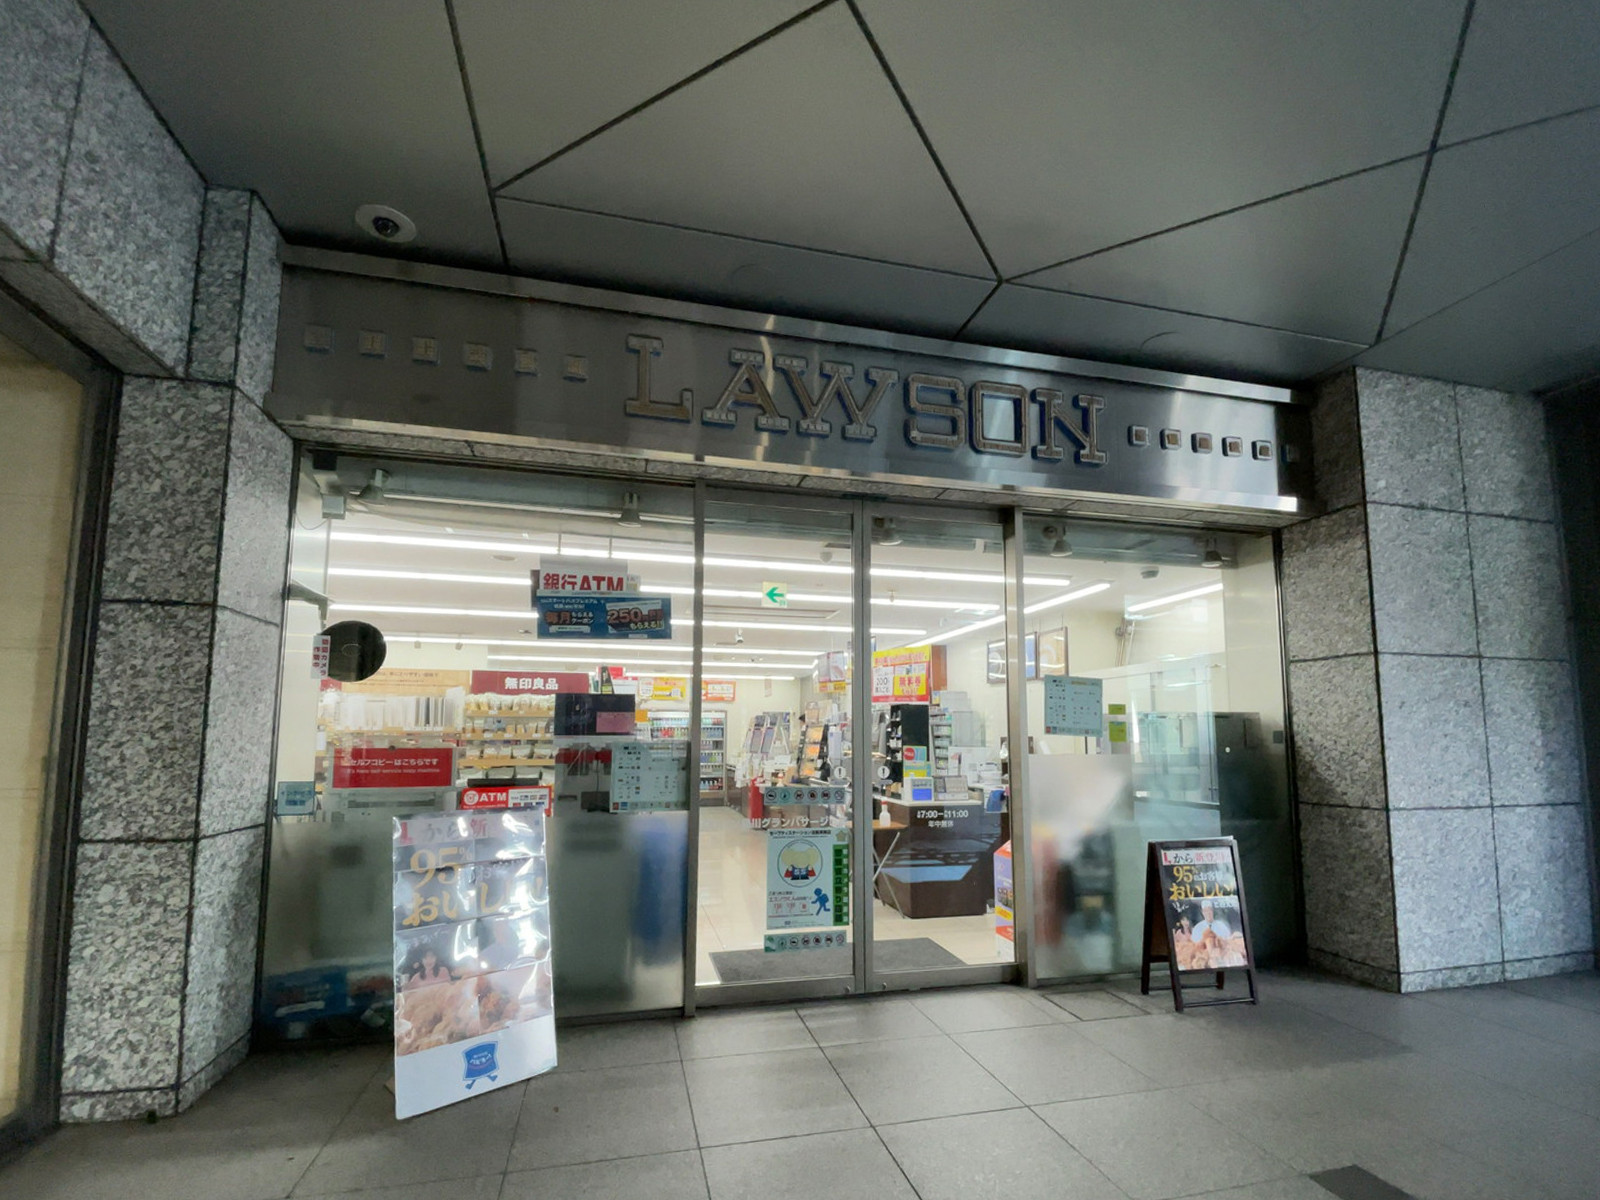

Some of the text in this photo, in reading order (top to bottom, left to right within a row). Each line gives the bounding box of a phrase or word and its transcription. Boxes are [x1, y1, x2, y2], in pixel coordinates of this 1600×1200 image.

[624, 333, 1108, 466] LAWSON
[543, 573, 624, 591] 銀行ATM
[504, 676, 559, 690] 無印良品
[350, 758, 439, 766] セルフコピーはこちらです
[480, 792, 507, 802] ATM
